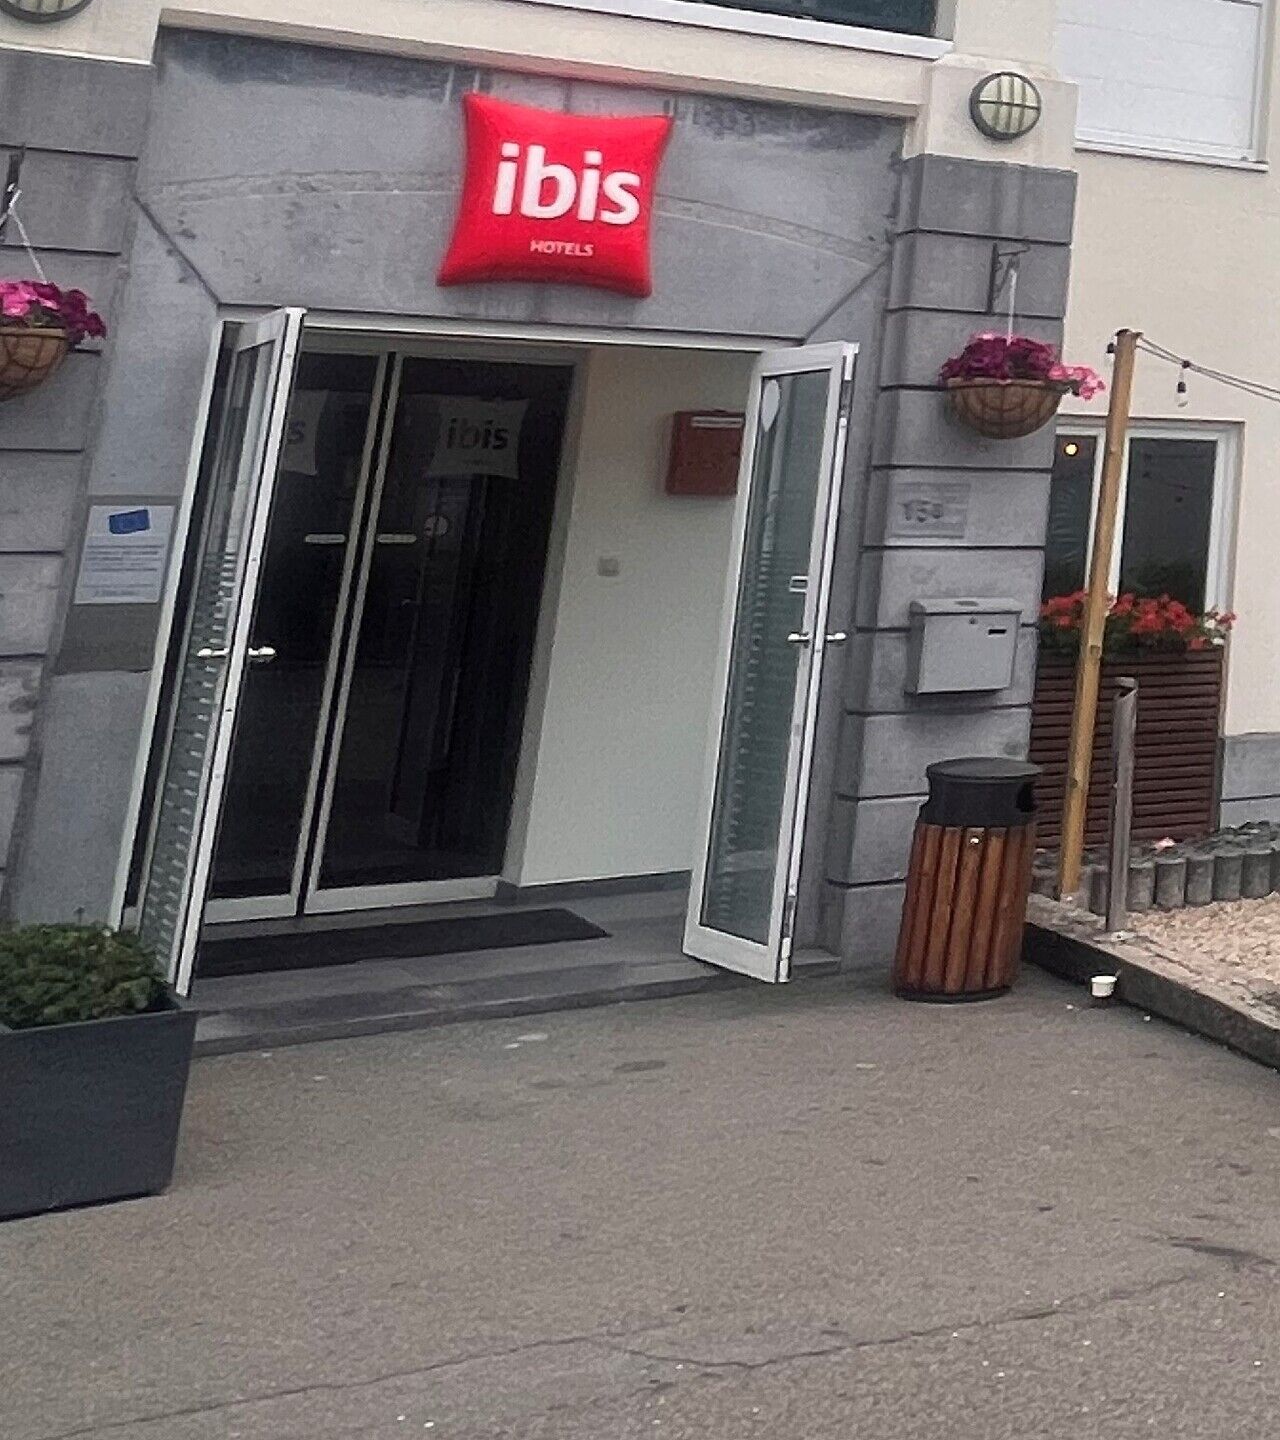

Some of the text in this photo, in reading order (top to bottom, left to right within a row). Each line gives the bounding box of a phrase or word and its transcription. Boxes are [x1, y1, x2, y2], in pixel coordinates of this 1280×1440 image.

[492, 141, 642, 226] ibis
[530, 239, 594, 257] HOTELS
[446, 416, 510, 451] ibis
